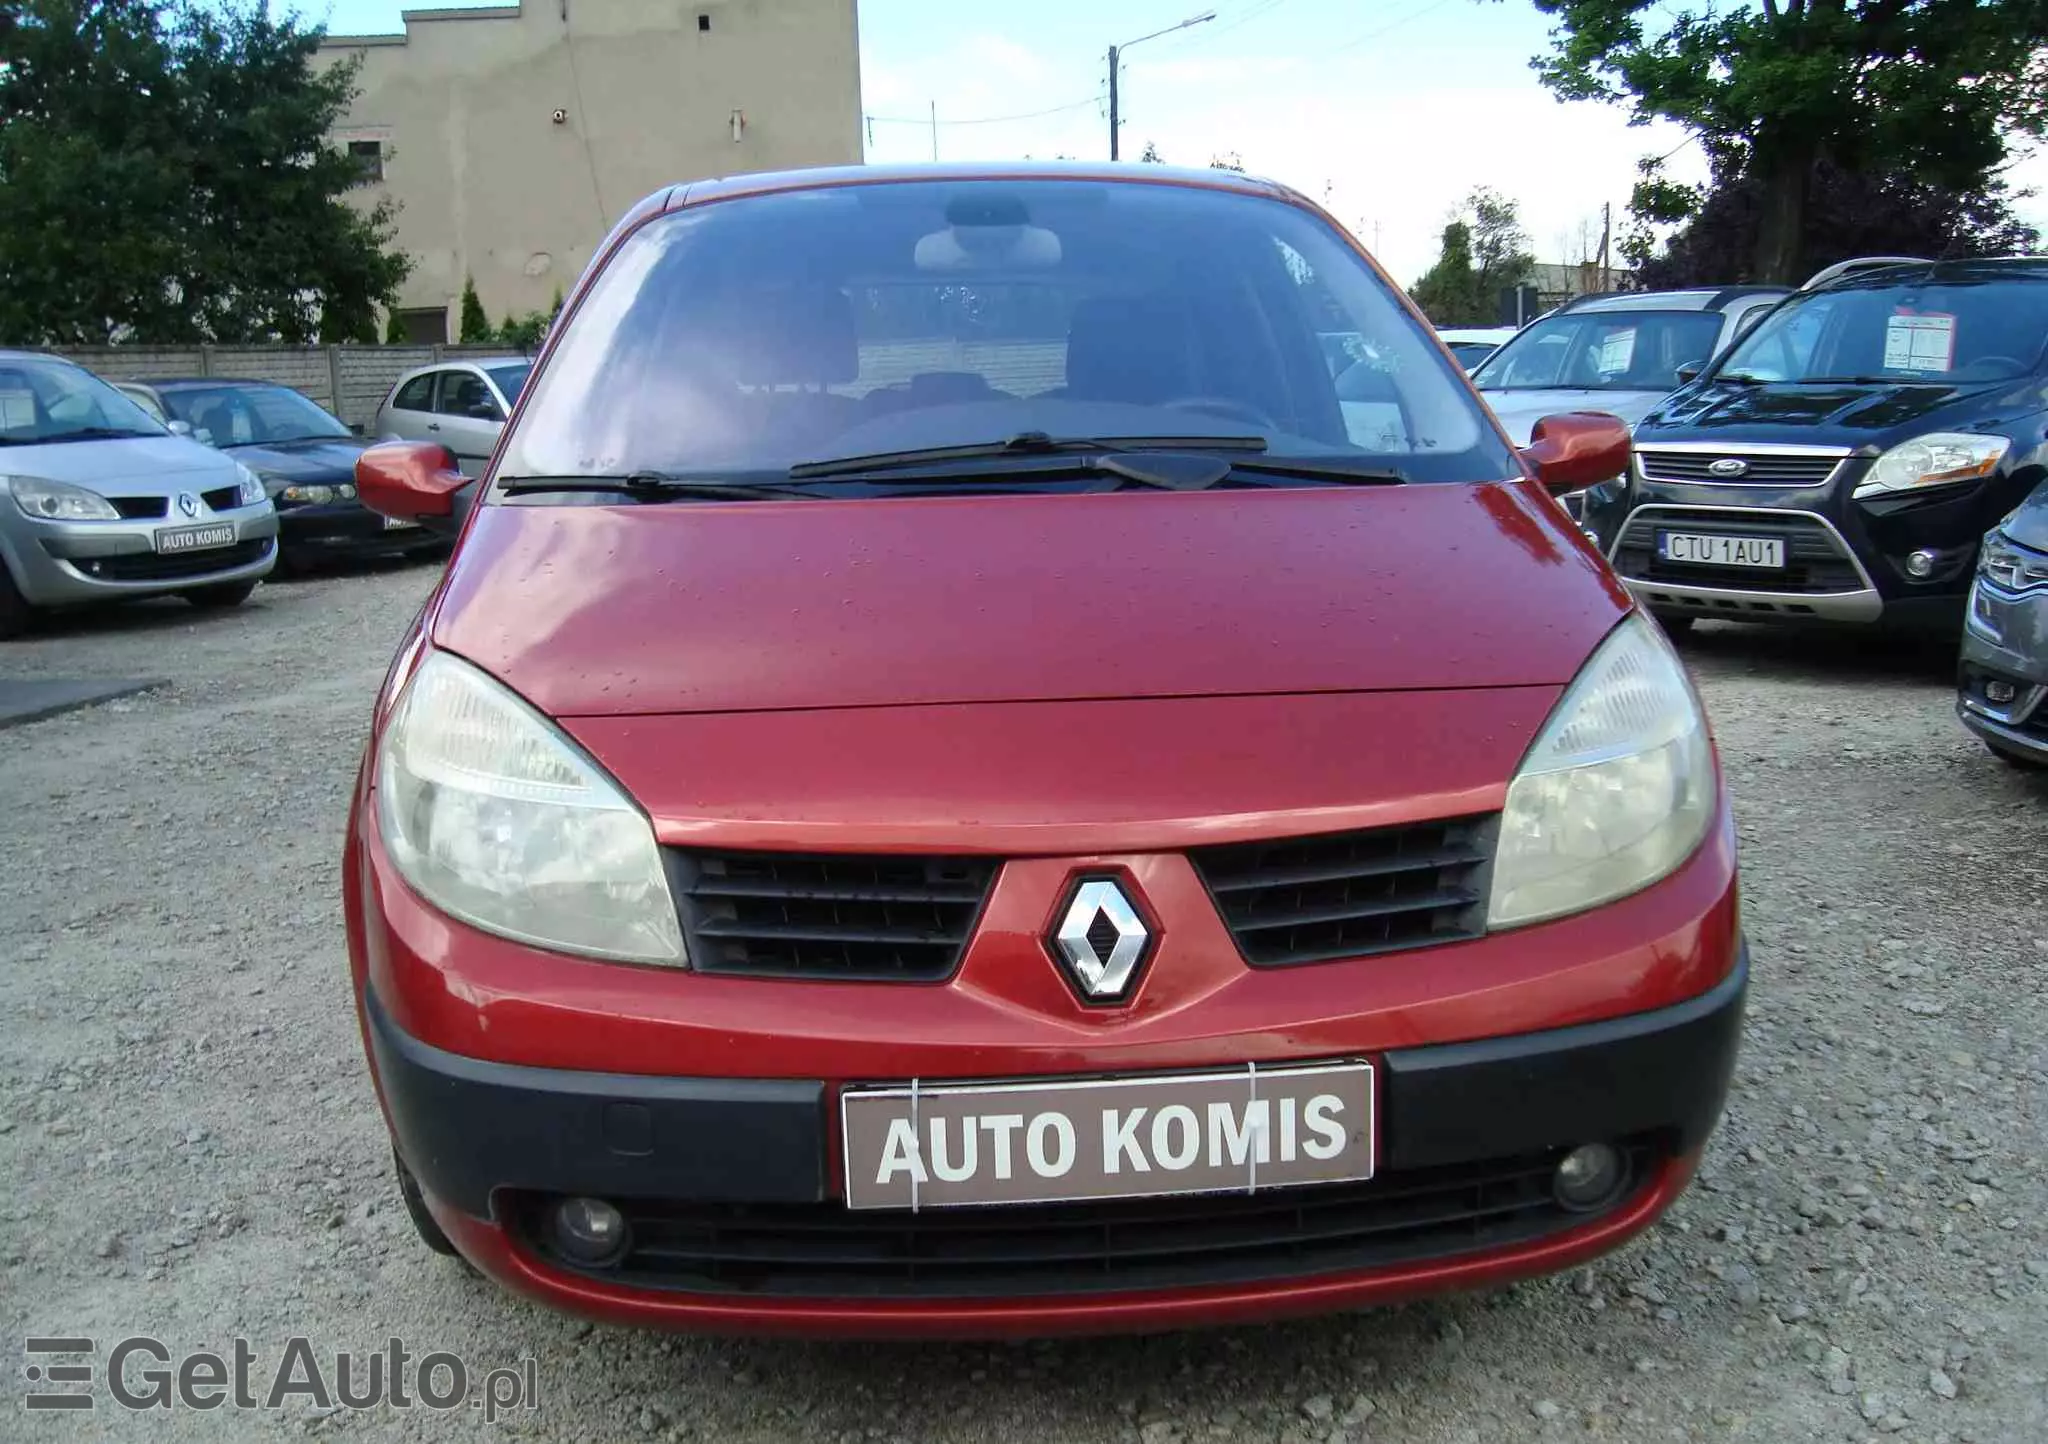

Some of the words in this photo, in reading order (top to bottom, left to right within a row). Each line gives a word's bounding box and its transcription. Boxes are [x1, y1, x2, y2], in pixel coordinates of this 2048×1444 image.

[163, 532, 194, 550] AUTO
[196, 527, 233, 545] KOMIS
[1672, 536, 1713, 560] CTU
[1722, 539, 1775, 565] 1AU1
[876, 1111, 1077, 1185] AUTO
[1101, 1094, 1347, 1175] KOMIS
